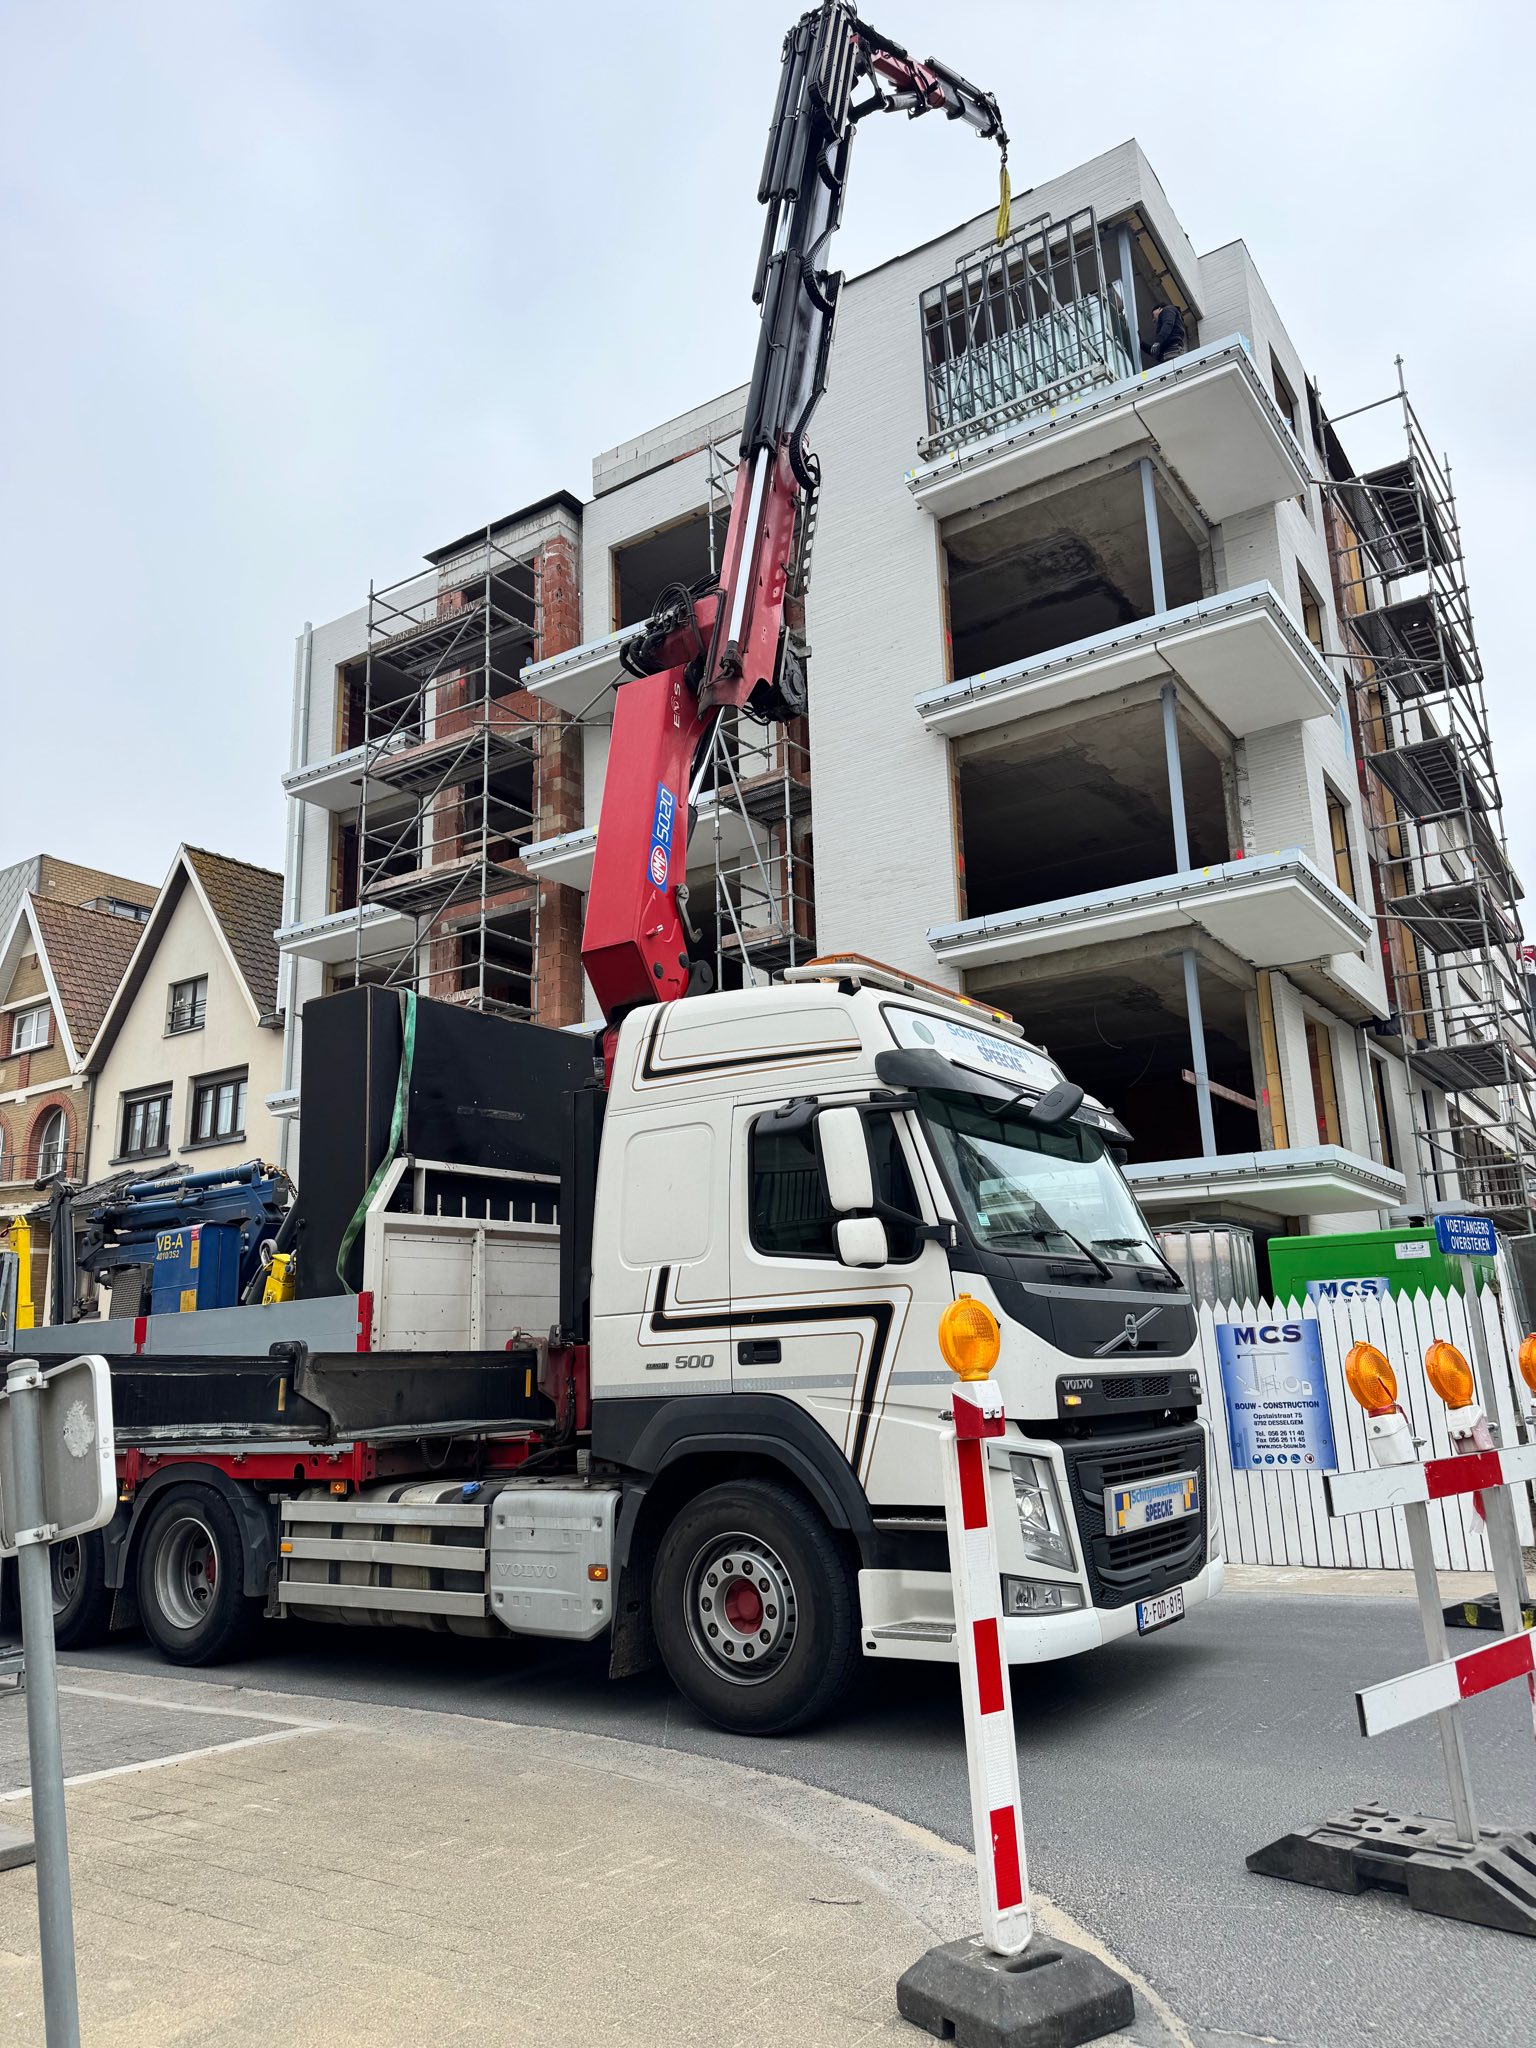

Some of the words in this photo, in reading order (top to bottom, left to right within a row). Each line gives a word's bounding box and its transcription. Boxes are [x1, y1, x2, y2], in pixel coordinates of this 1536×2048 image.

[656, 788, 673, 842] 5020
[652, 849, 667, 881] HMF
[977, 1045, 1027, 1074] SPEECKE
[1444, 1218, 1490, 1235] VOETGANGERS
[156, 1233, 184, 1252] VB-A
[1450, 1235, 1491, 1251] OVERSTEKEN
[1318, 1280, 1378, 1298] MCS
[1233, 1324, 1302, 1346] MCS
[675, 1354, 715, 1369] 500
[1062, 1378, 1094, 1391] VOLVO
[1235, 1402, 1257, 1410] BOUW
[1262, 1400, 1320, 1409] CONSTRUCTION
[1145, 1498, 1174, 1523] SPEECKE
[495, 1562, 558, 1579] VOLVO
